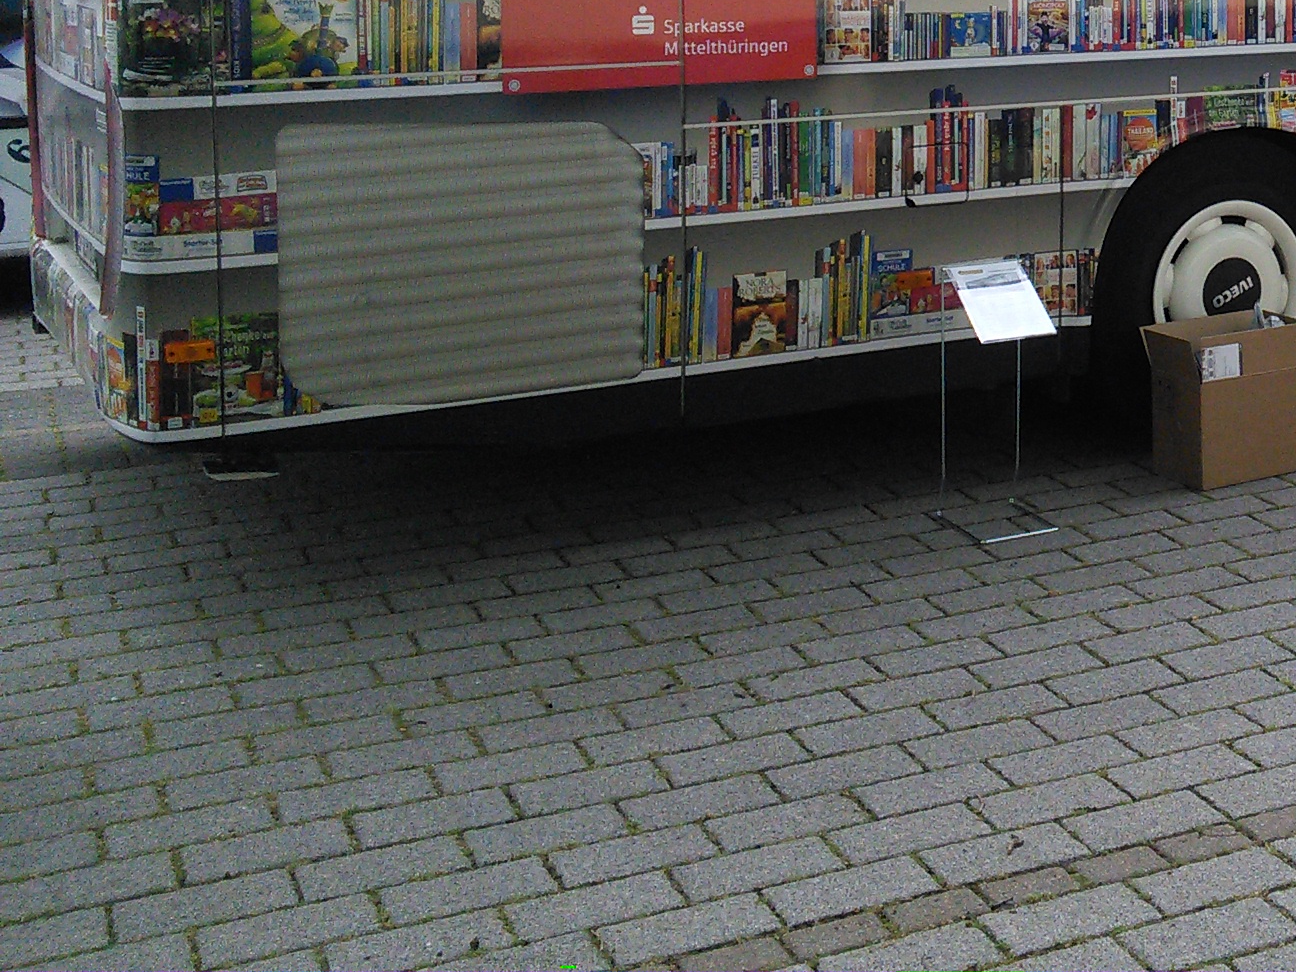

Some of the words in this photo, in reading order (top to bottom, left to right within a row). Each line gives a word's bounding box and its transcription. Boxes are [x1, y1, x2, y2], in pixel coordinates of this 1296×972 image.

[663, 18, 745, 35] Sparkasse
[664, 38, 789, 57] Mttelthüringen
[1212, 276, 1254, 309] IVECO
